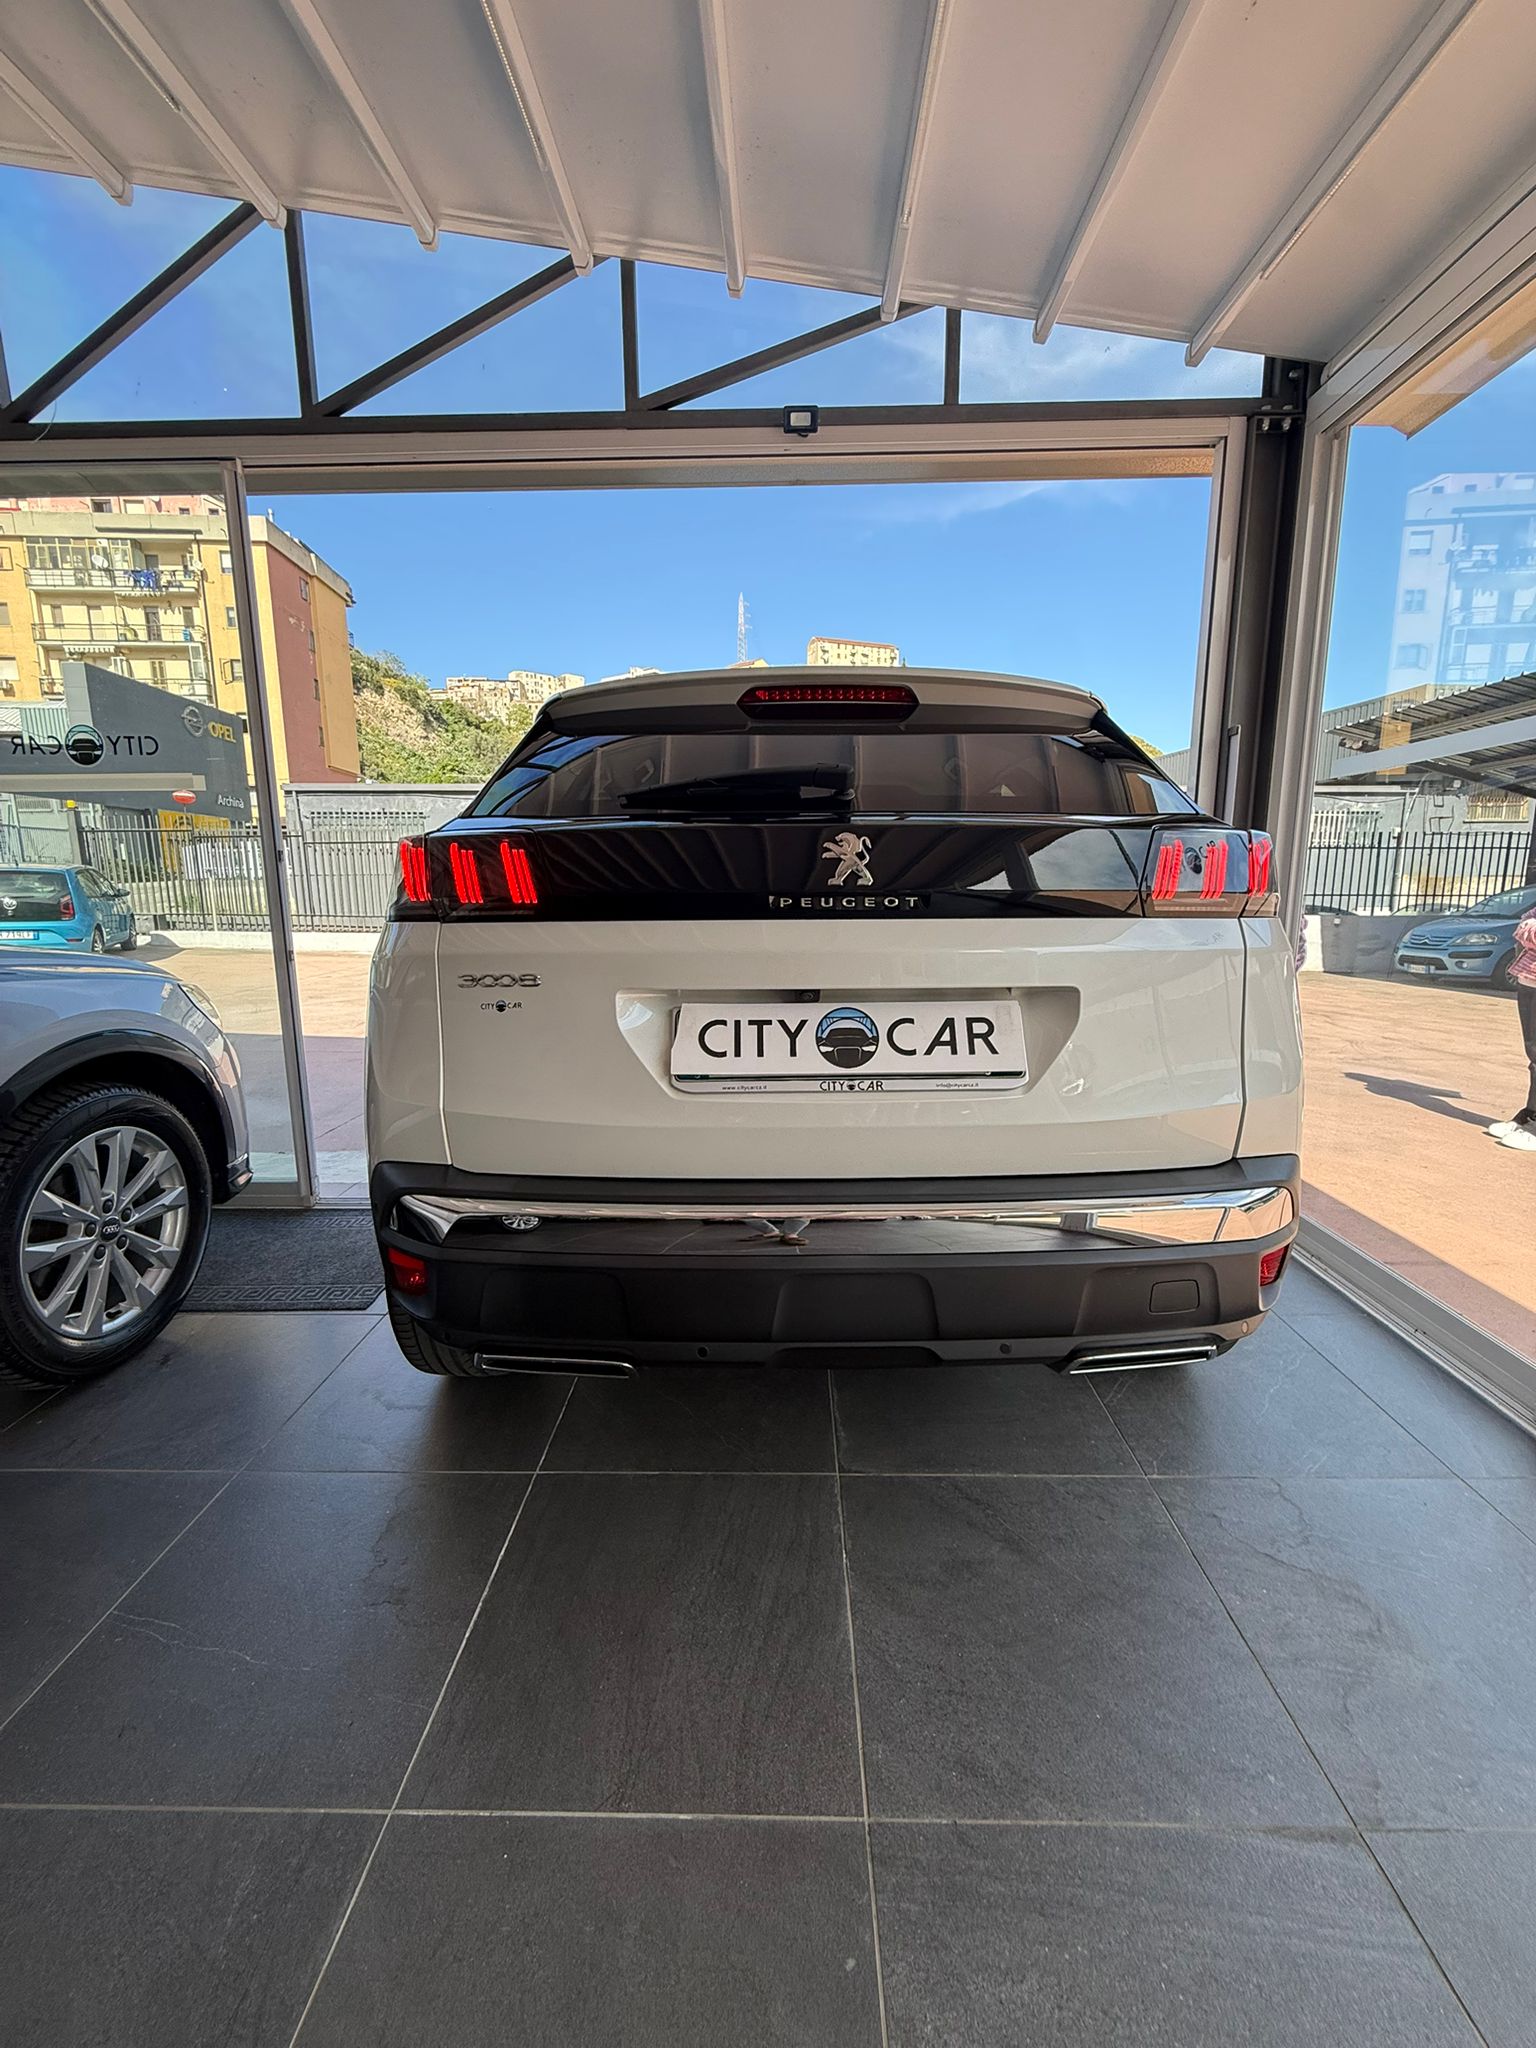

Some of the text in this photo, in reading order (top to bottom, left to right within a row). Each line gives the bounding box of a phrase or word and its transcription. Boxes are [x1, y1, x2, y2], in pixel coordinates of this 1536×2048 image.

[207, 721, 237, 743] OPEL
[779, 896, 919, 908] PEUGEOT
[457, 973, 542, 989] 3008
[698, 1016, 1000, 1059] CITY CAR
[819, 1080, 885, 1091] CITY CAR
